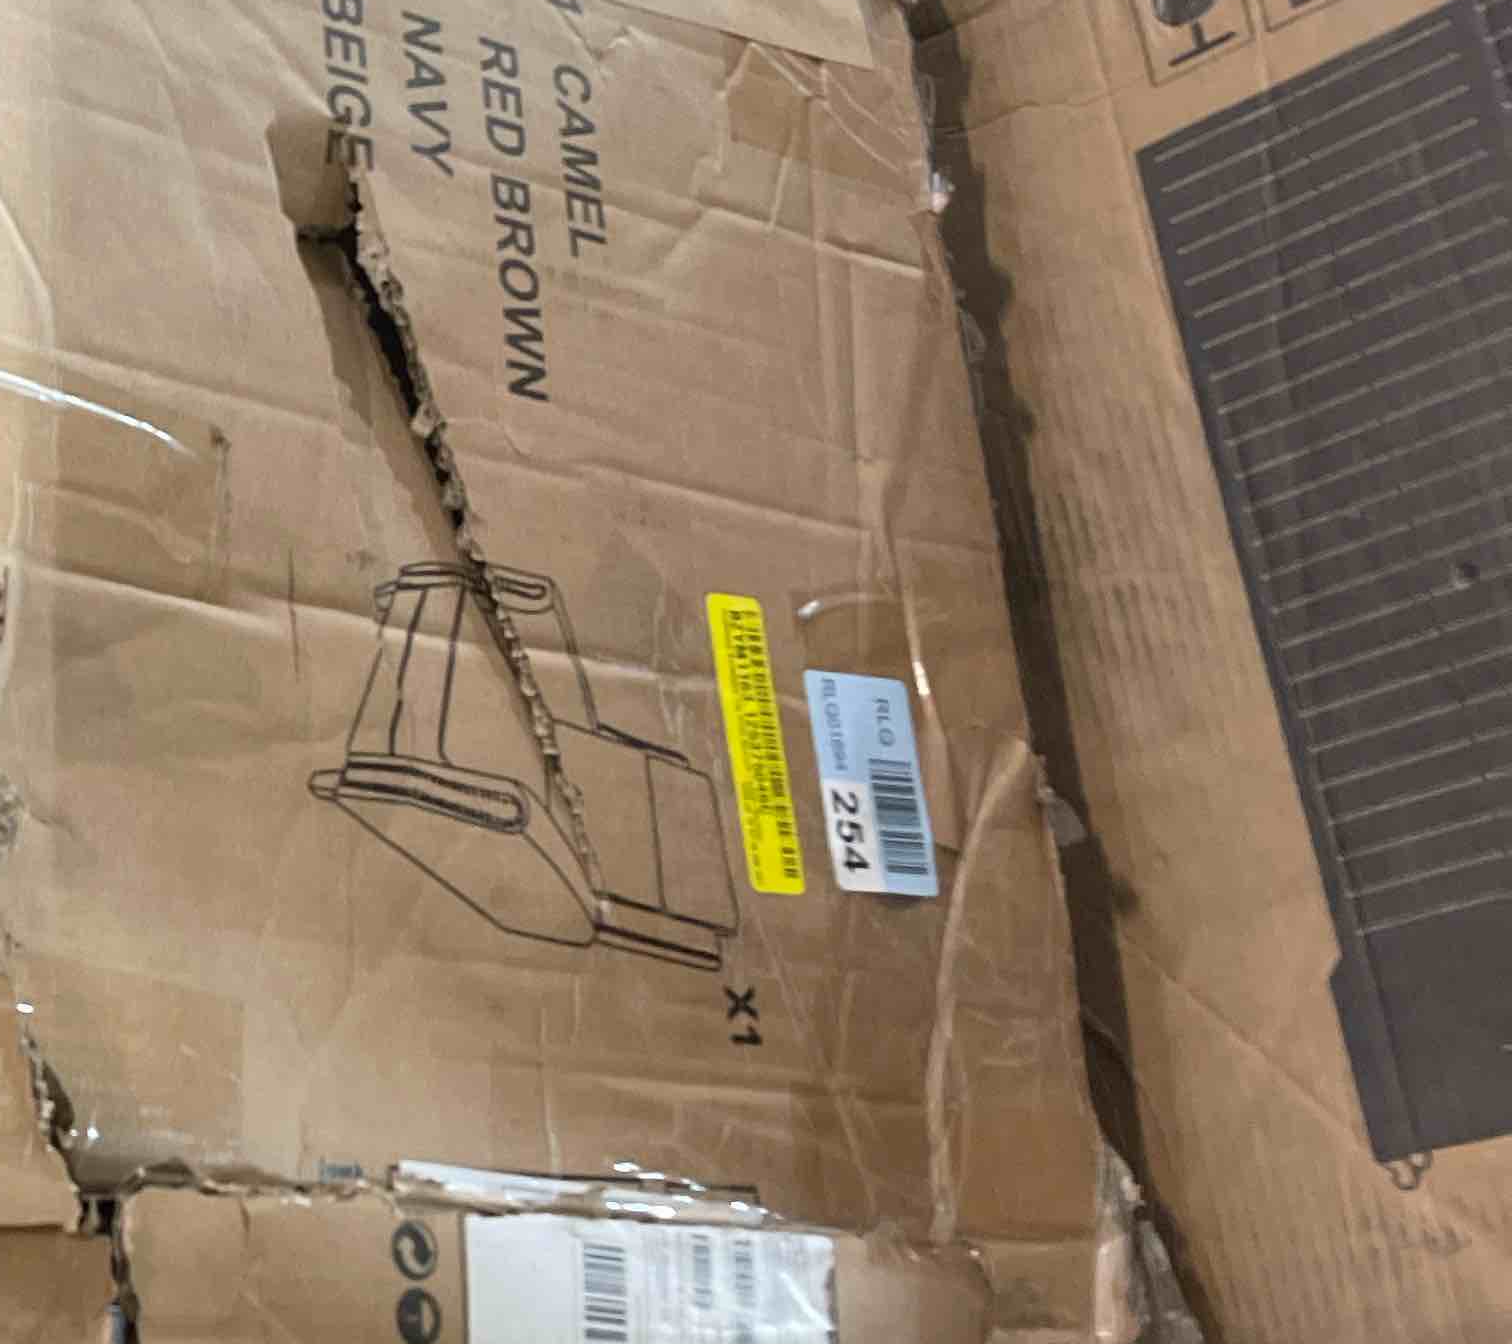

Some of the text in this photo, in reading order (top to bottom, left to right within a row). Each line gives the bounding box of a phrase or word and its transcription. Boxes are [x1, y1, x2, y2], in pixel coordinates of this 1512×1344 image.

[401, 10, 455, 178] NAVY
[478, 35, 527, 158] RED
[552, 63, 608, 261] CAMEL
[490, 172, 550, 404] BROWN
[830, 787, 871, 874] 254
